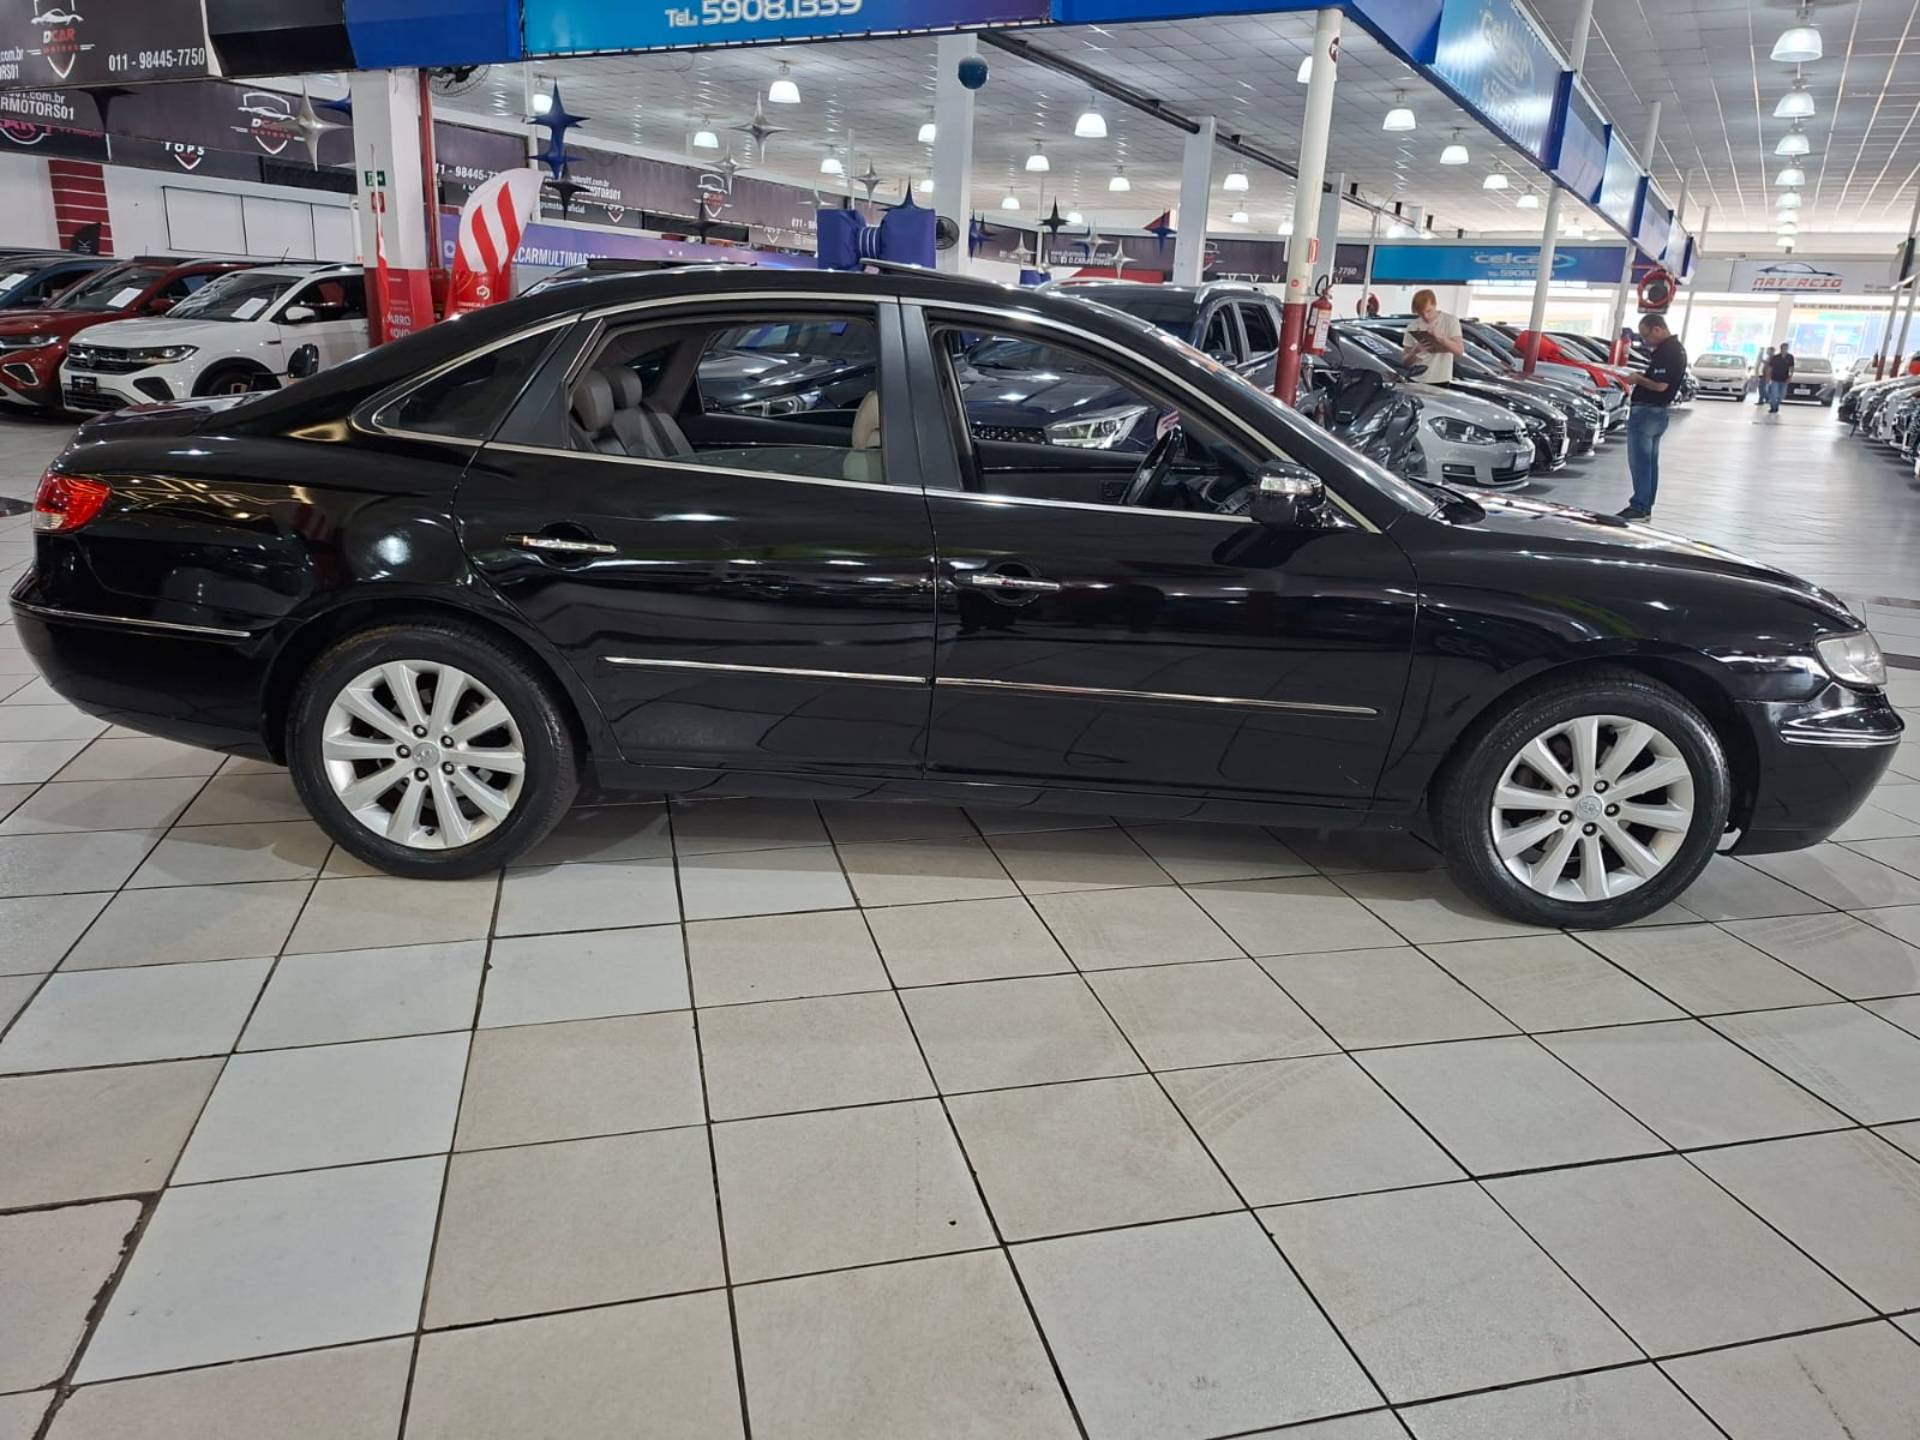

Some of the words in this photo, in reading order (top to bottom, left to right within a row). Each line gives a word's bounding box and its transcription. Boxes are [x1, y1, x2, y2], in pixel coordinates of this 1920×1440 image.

[43, 28, 76, 43] DCAR
[108, 54, 128, 72] 011
[138, 48, 205, 69] 98445-7750
[163, 142, 204, 155] TOPS
